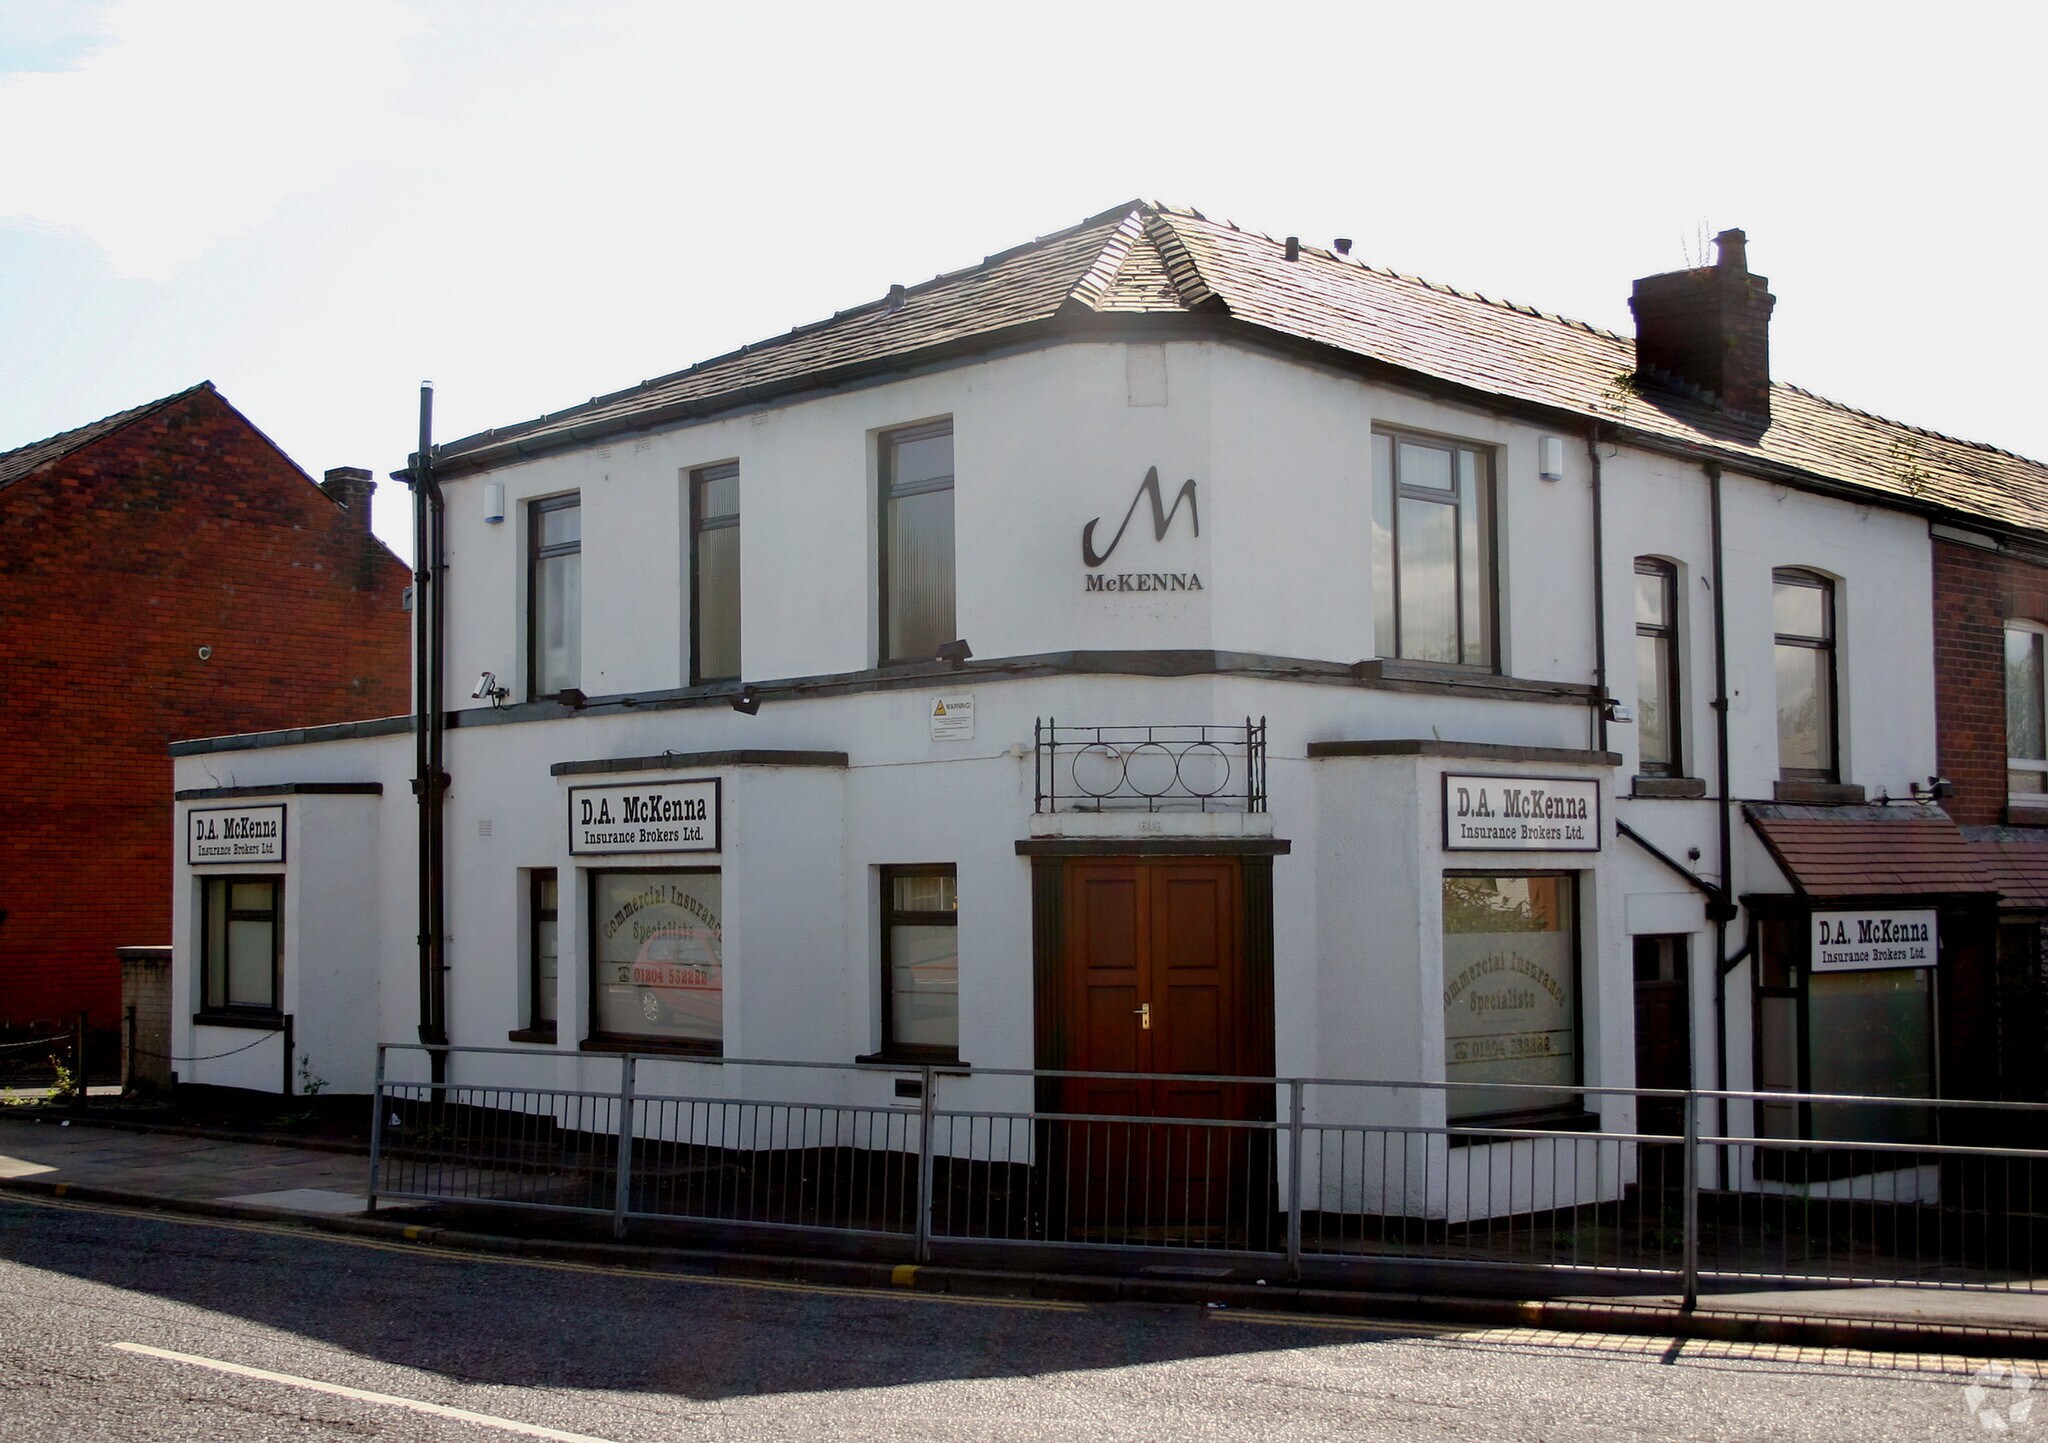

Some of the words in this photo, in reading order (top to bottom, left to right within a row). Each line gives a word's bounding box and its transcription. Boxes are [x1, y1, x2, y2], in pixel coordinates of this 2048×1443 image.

[1085, 572, 1204, 592] McKENNA
[581, 798, 616, 825] D.A.
[623, 795, 707, 824] McKenna
[1457, 787, 1495, 818] D.A.
[1503, 788, 1588, 820] McKenna
[196, 819, 219, 841] D.A.
[224, 817, 278, 839] McKenna
[584, 830, 636, 845] Insurance
[639, 828, 679, 844] Brokers
[683, 826, 704, 842] Ltd.
[1460, 823, 1517, 840] Insurance
[1520, 824, 1561, 840] Brokers
[1565, 825, 1585, 840] Ltd.
[198, 845, 231, 856] Insurance
[233, 843, 260, 855] Brokers
[261, 842, 275, 854] Ltd.
[604, 885, 666, 940] Commercial
[633, 920, 694, 944] Specialists
[1819, 920, 1851, 945] D.A.
[1857, 919, 1929, 944] McKenna
[1822, 950, 1869, 963] Insurance
[1872, 948, 1906, 961] Brokers
[1909, 947, 1926, 960] Ltd.
[634, 967, 664, 983] 01204
[1443, 951, 1505, 1012] ommercial
[1511, 951, 1565, 1008] Insurance
[1470, 988, 1535, 1015] Specialists
